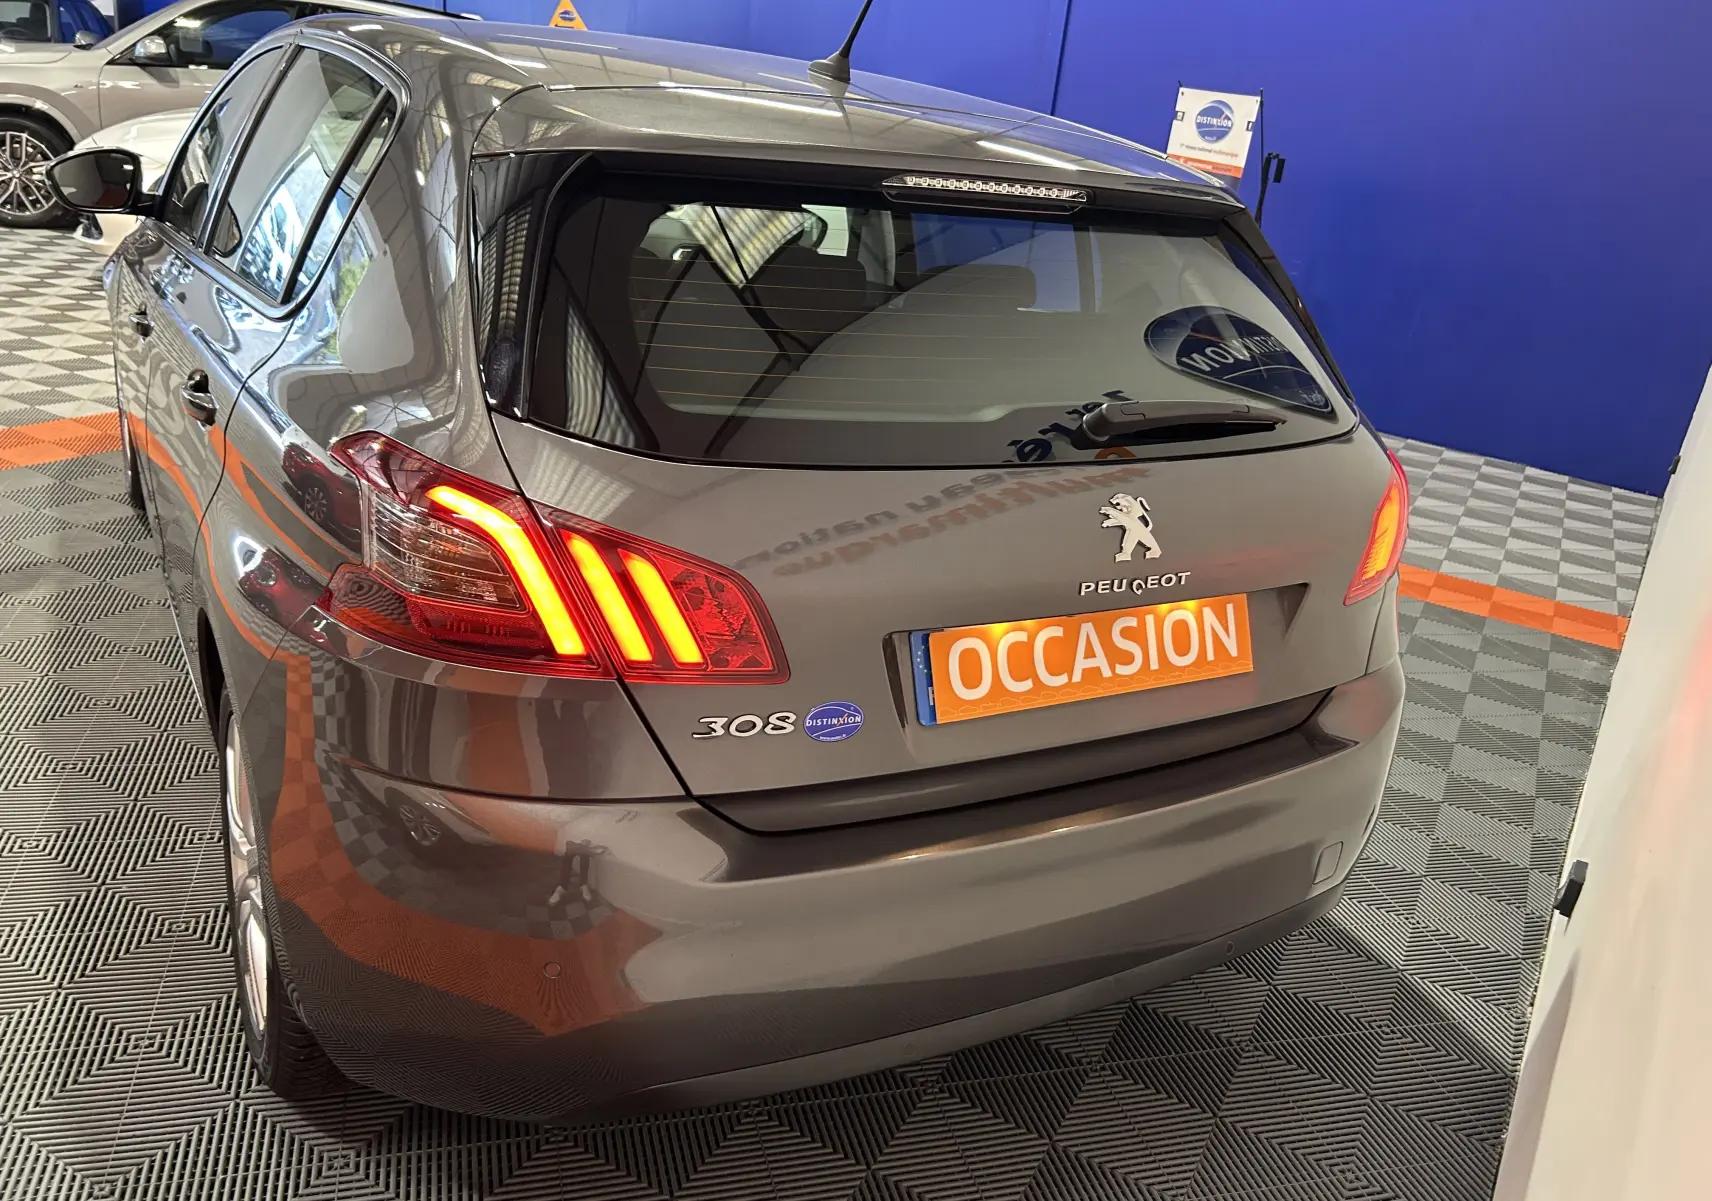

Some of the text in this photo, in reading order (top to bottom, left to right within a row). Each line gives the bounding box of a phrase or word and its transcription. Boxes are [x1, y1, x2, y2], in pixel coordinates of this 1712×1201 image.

[1079, 571, 1191, 596] PEUGEOT
[948, 603, 1239, 701] OCCASION
[692, 711, 797, 738] 308
[805, 713, 862, 727] DISTINXION
